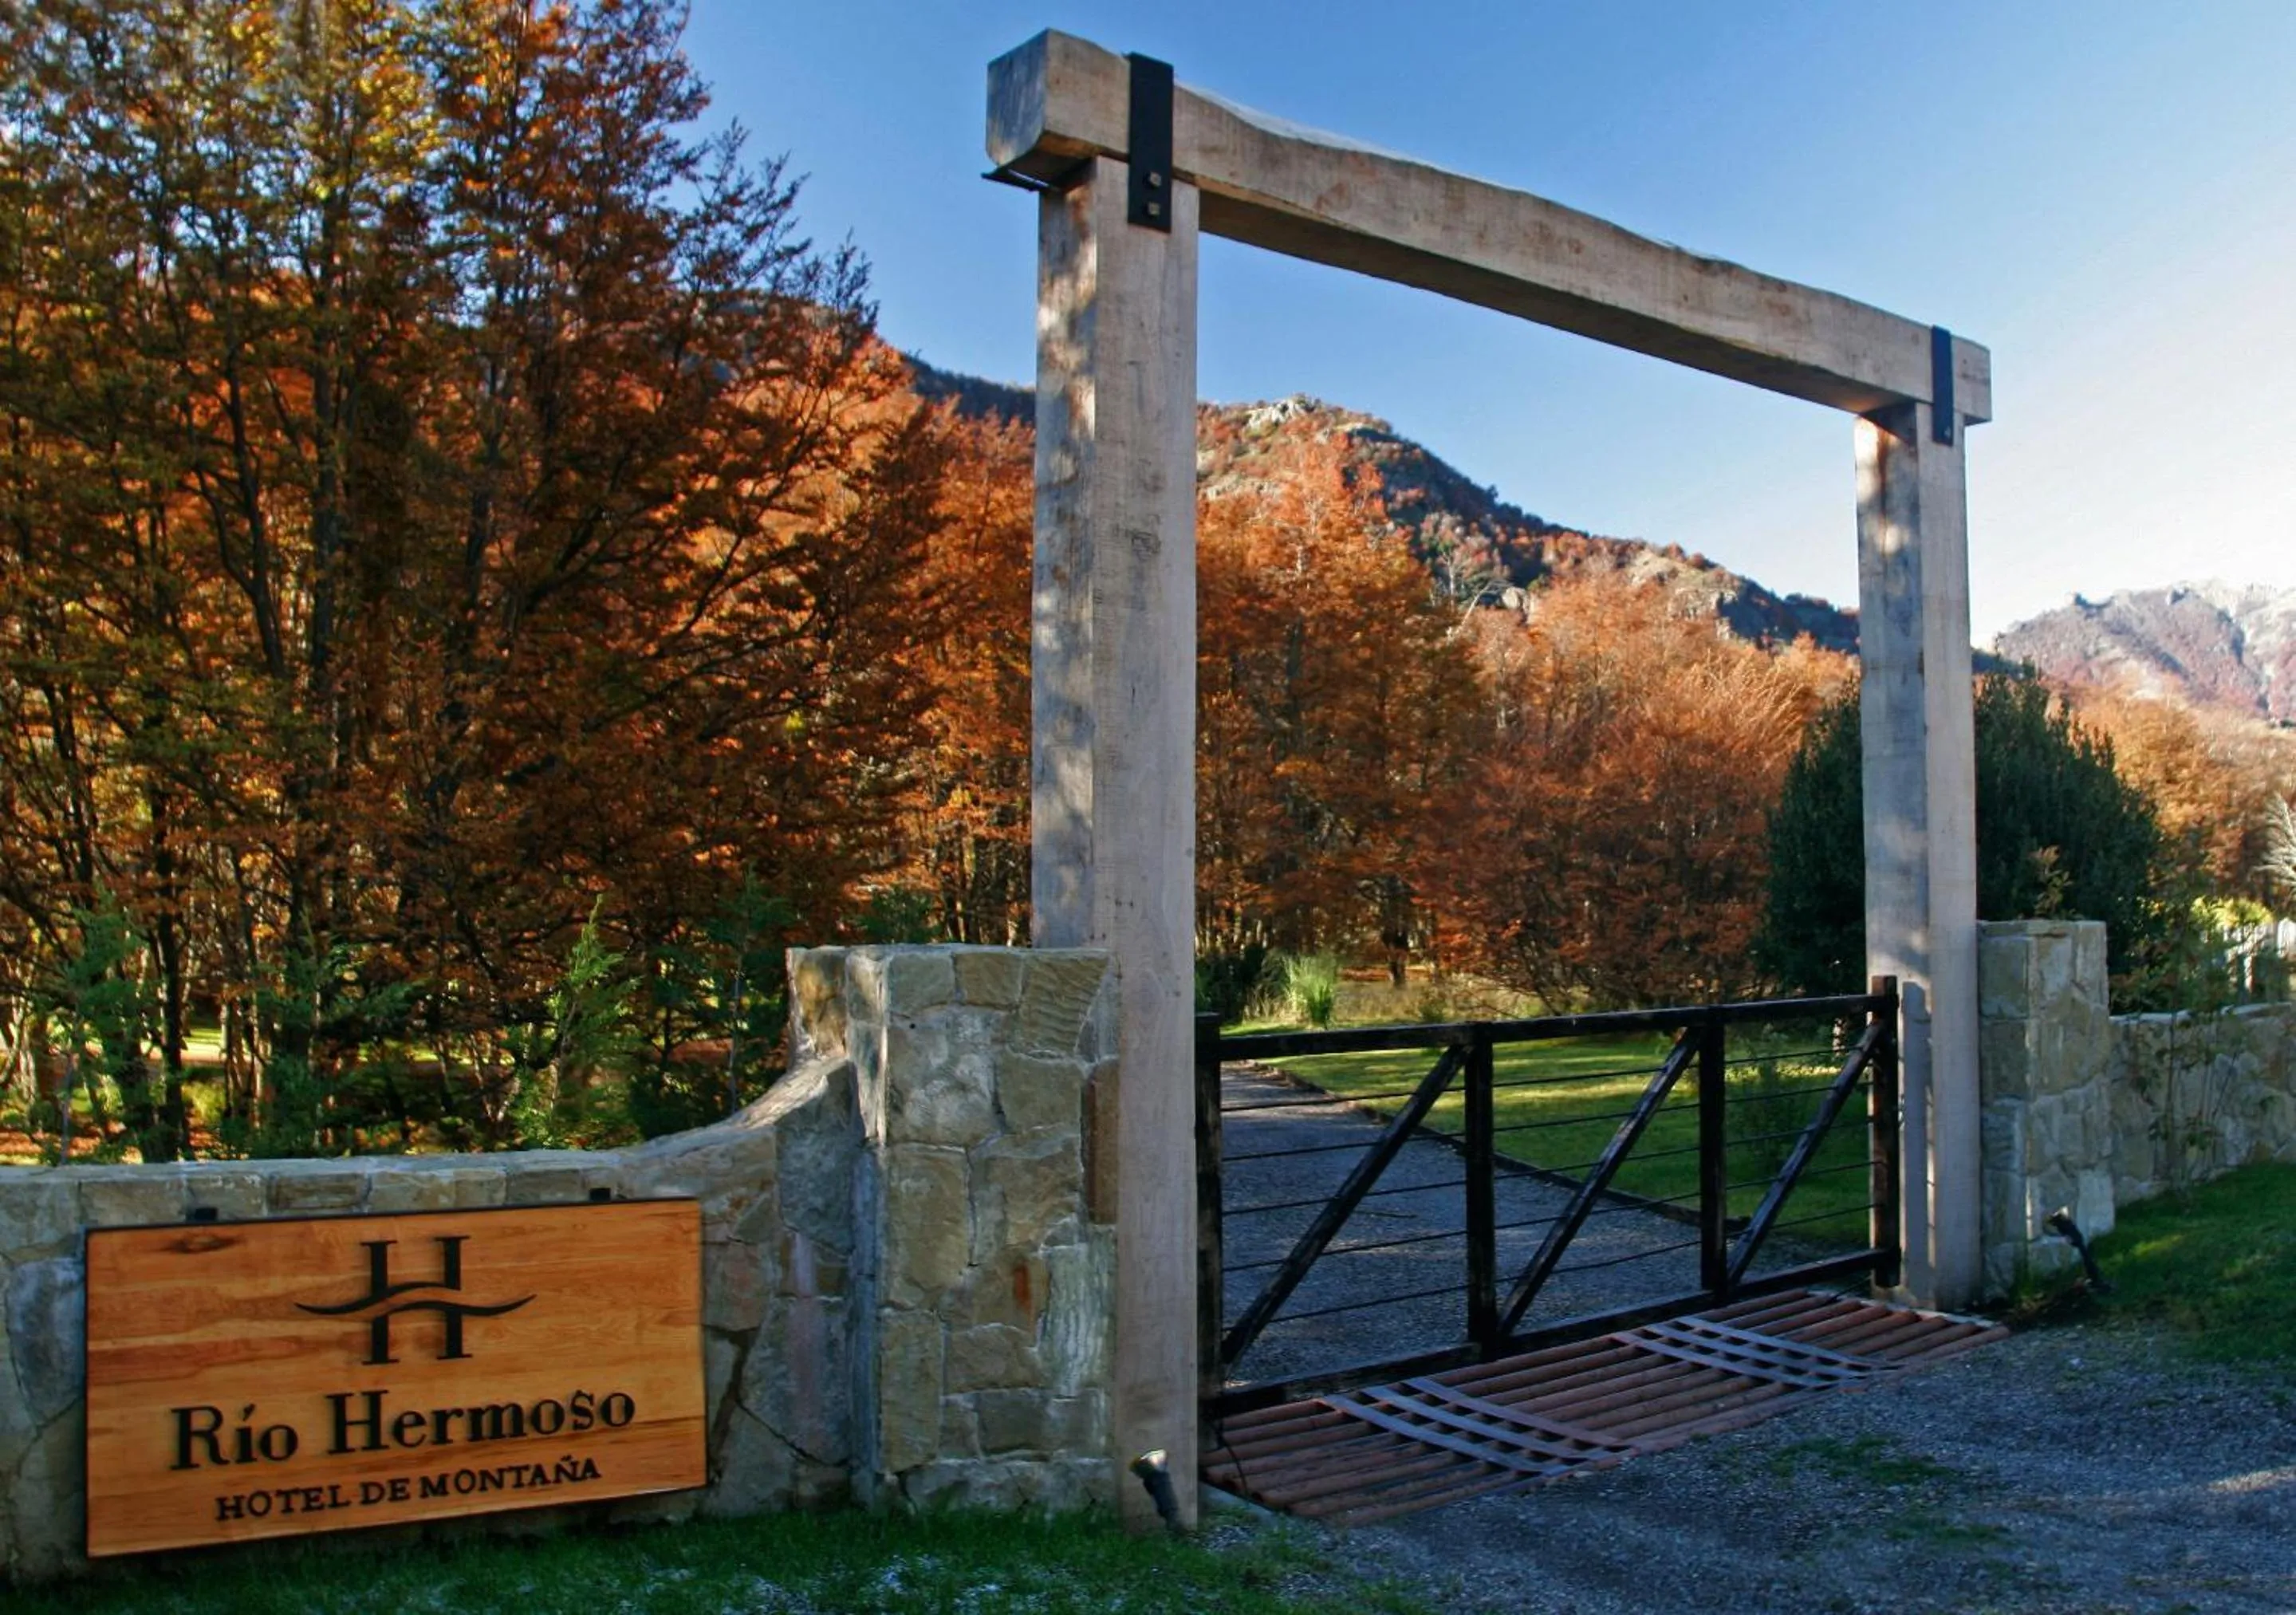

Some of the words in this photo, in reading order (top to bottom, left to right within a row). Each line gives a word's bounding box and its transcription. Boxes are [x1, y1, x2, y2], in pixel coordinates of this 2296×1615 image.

[168, 1404, 300, 1472] Río
[325, 1389, 636, 1455] Hermoso
[214, 1483, 351, 1522] HOTEL
[360, 1480, 412, 1505] DE
[419, 1455, 602, 1499] MONTAÑA
